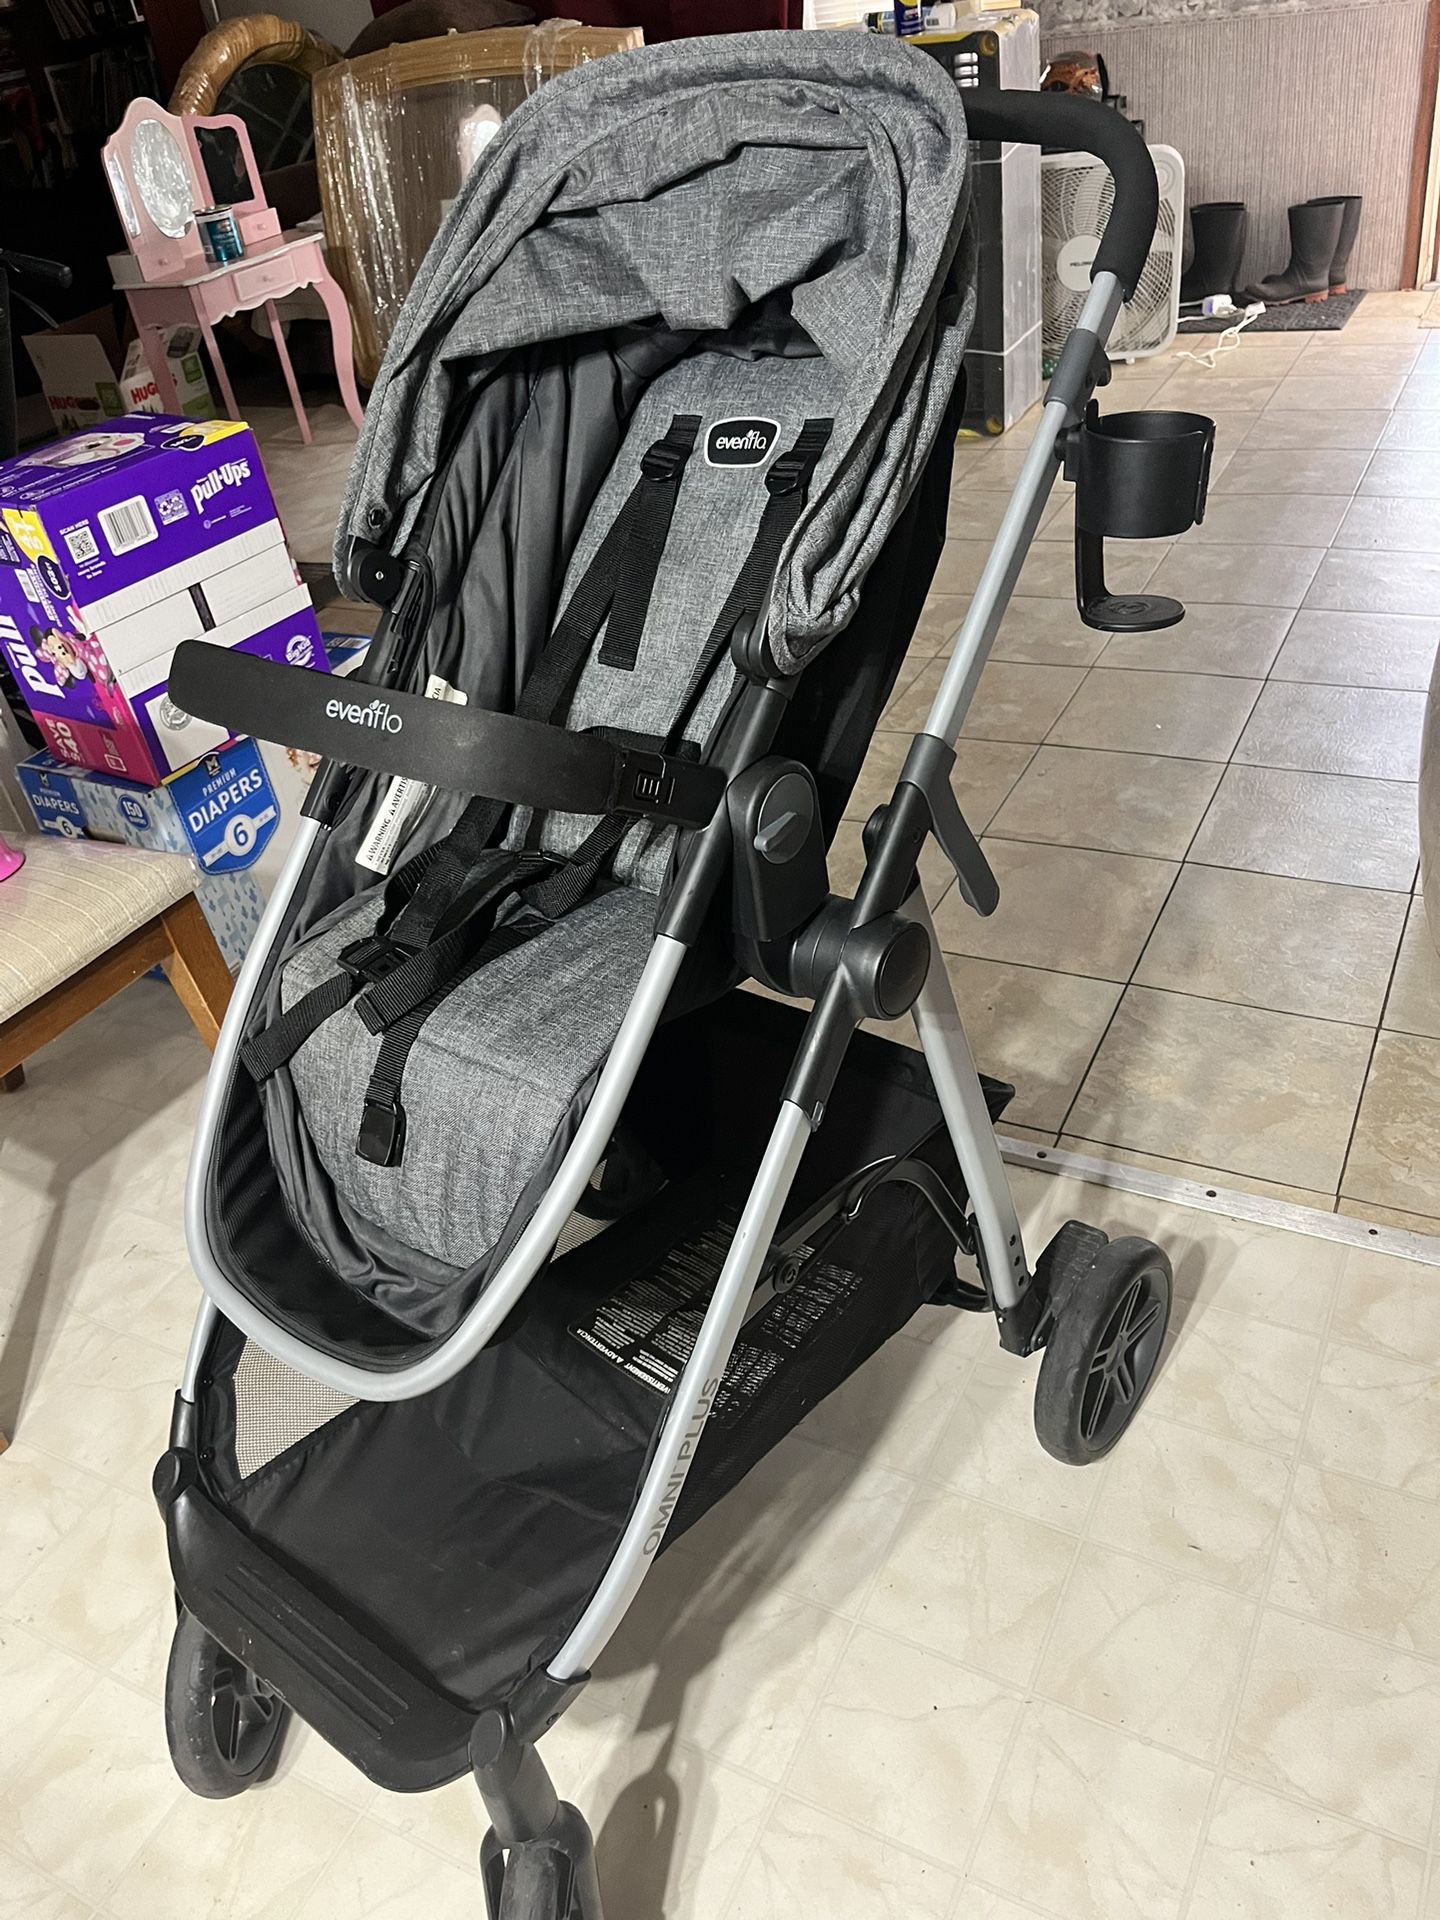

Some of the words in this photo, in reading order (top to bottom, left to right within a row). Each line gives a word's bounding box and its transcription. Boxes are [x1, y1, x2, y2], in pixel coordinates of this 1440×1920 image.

[715, 429, 767, 450] evenflo
[326, 699, 403, 734] evenflo
[202, 767, 237, 796] PREMIUM
[31, 794, 80, 815] DIAPERS
[122, 801, 143, 818] 150
[188, 768, 263, 833] DIAPERS
[62, 820, 73, 835] 6
[233, 822, 249, 847] 6
[368, 818, 391, 854] WARNING
[643, 1472, 685, 1556] OMNI
[677, 1377, 719, 1461] PLUS
